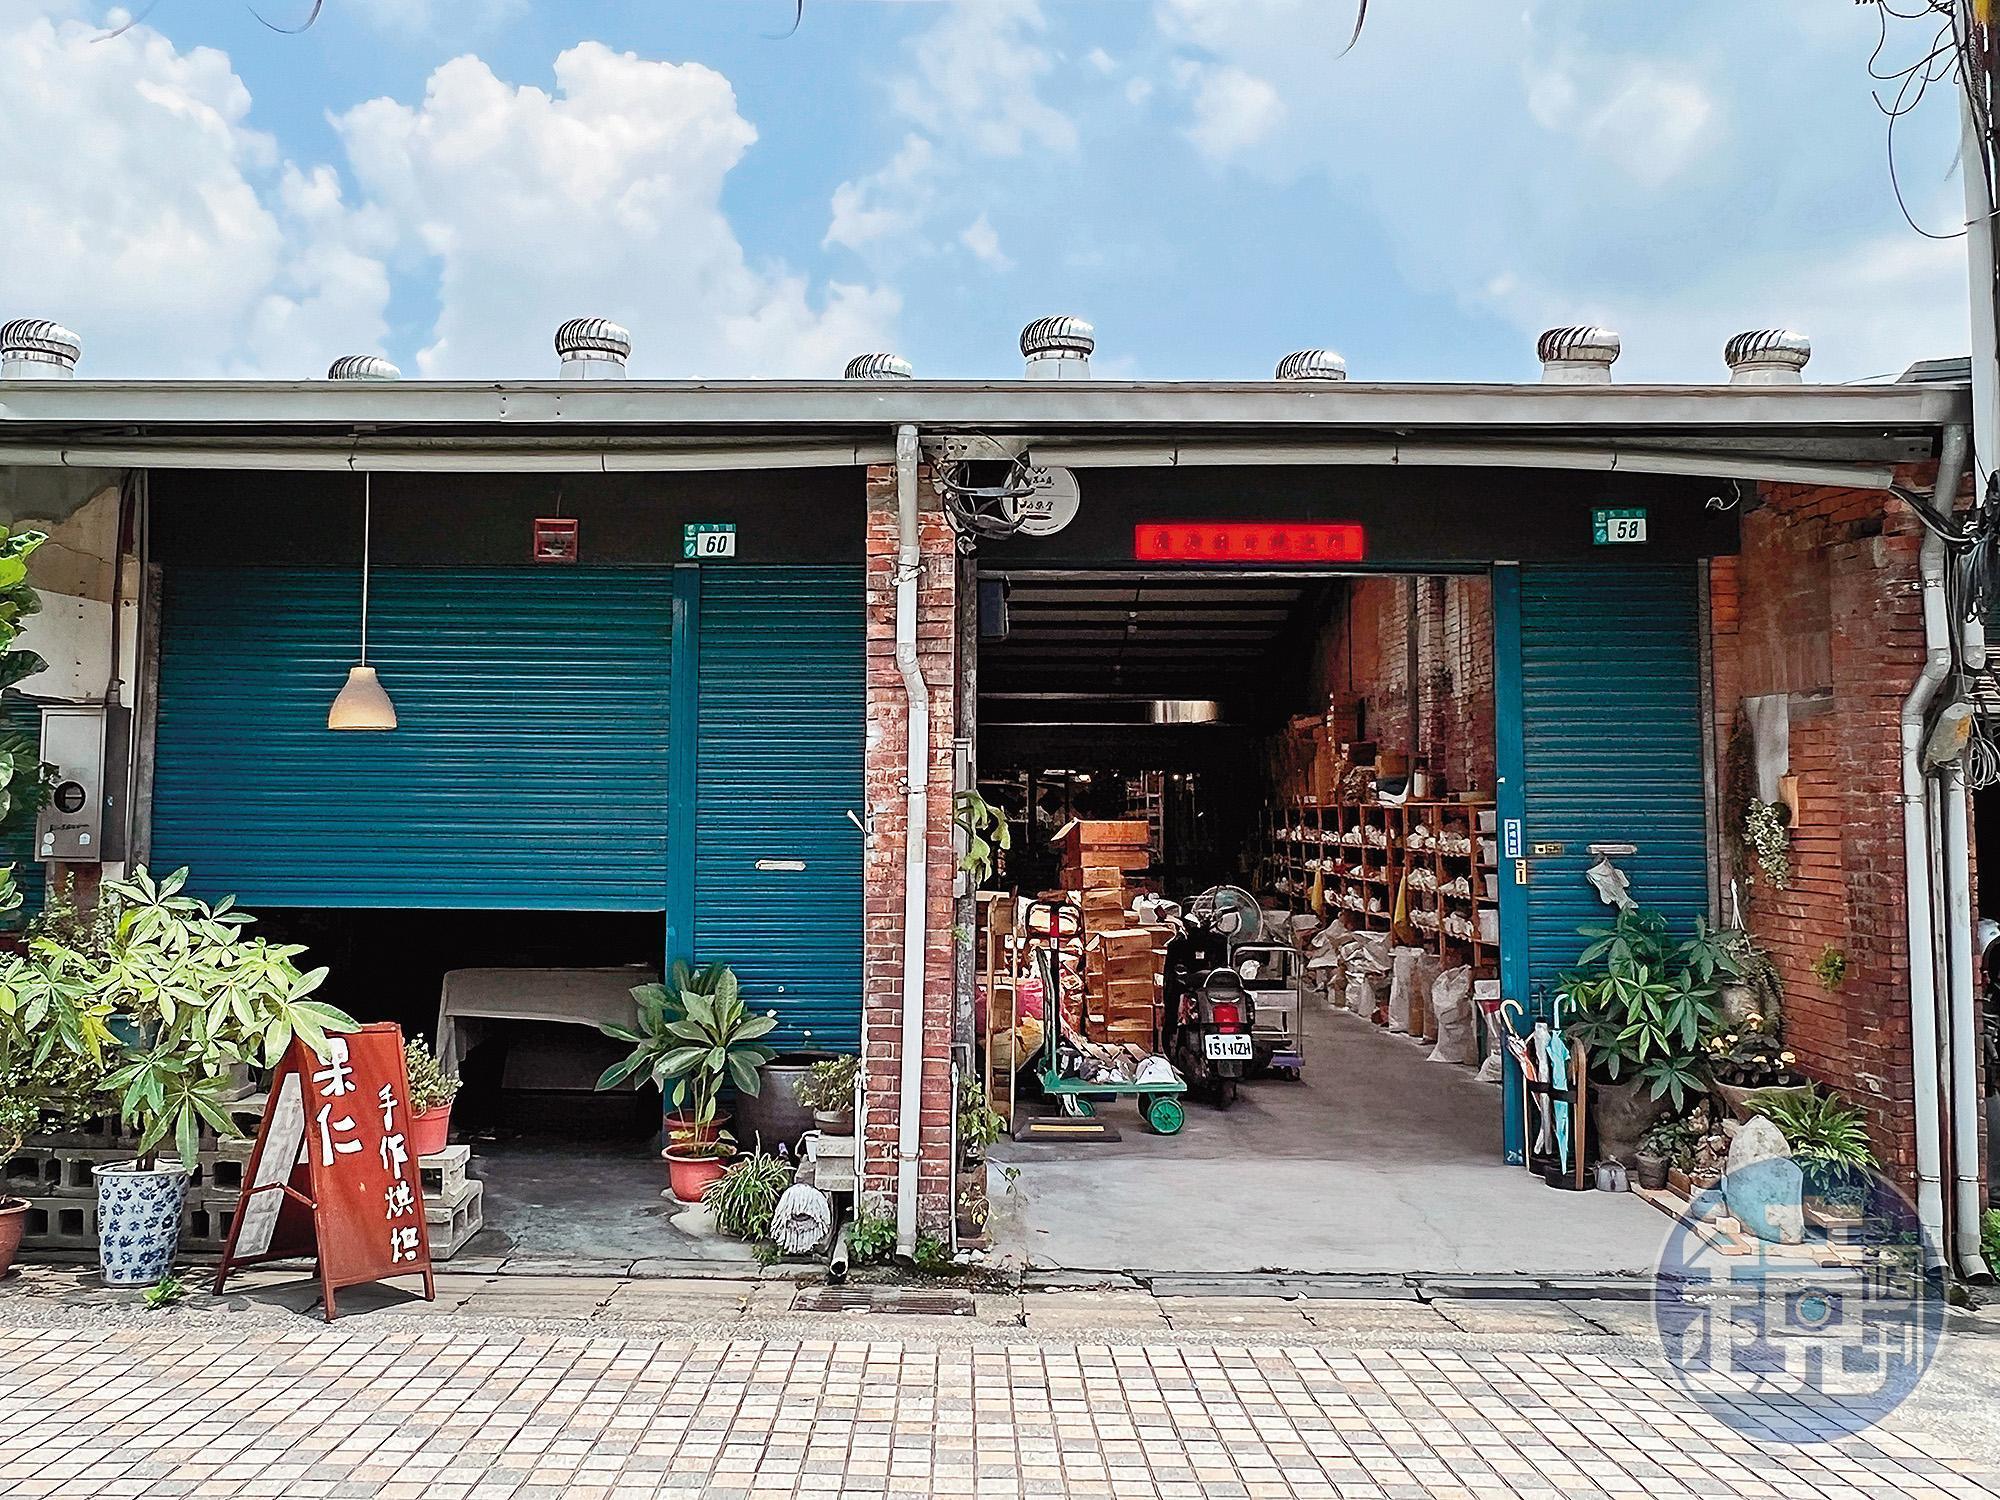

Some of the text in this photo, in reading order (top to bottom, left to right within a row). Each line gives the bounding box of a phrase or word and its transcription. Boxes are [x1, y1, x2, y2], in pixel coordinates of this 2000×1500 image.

[705, 535, 728, 554] 60
[1616, 520, 1639, 539] 58
[311, 1036, 364, 1167] 果仁
[378, 1082, 420, 1265] 手作烘焙
